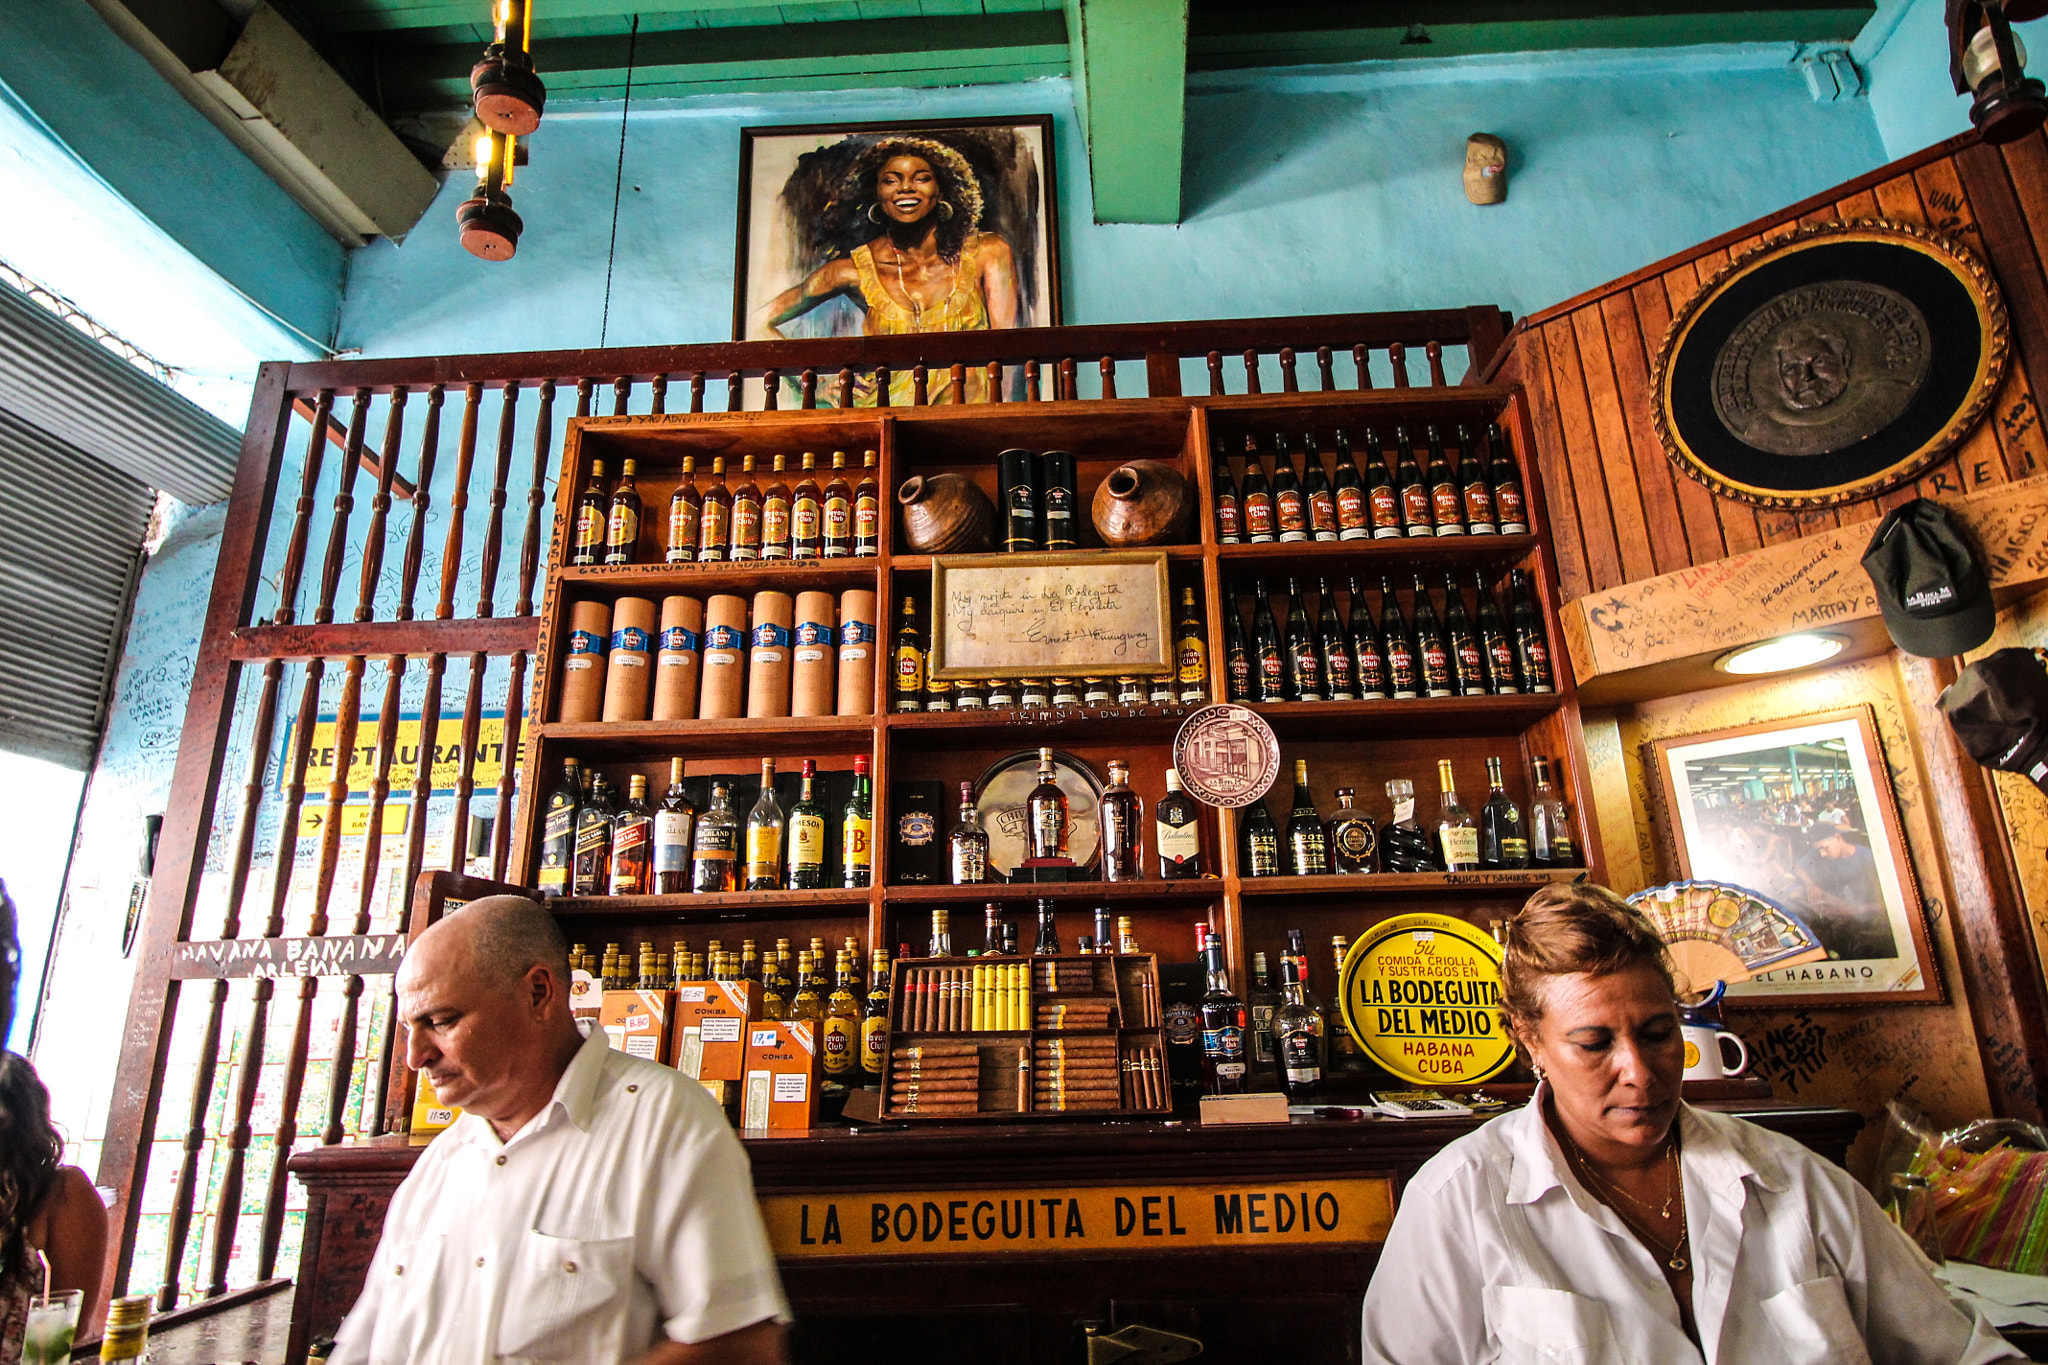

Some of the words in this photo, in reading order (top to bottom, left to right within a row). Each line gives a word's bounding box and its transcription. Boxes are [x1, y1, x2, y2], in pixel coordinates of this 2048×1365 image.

[1928, 189, 1964, 213] IVAN
[1248, 505, 1270, 513] Havana
[767, 515, 782, 523] Club
[830, 514, 844, 522] Club
[952, 591, 972, 607] My
[980, 586, 1012, 606] mojito
[1020, 591, 1037, 600] in
[1041, 587, 1060, 599] La
[1065, 583, 1125, 601] Bodeguita
[952, 606, 973, 631] My
[1033, 606, 1046, 615] in
[1297, 655, 1318, 663] Havana
[1358, 654, 1381, 662] Havana
[1388, 653, 1412, 661] Havana
[1424, 651, 1446, 660] Havana
[1430, 657, 1444, 665] Club
[1261, 659, 1282, 667] Havana
[1393, 659, 1408, 667] Club
[129, 697, 173, 716] DANIEL
[1000, 810, 1027, 823] CHIV
[697, 830, 730, 838] HIGHLAND
[703, 836, 720, 844] PARK
[181, 940, 272, 962] HAVANA
[286, 934, 405, 962] BANANA
[1377, 955, 1422, 966] COMIDA
[1427, 956, 1476, 967] CRIOLLA
[1378, 965, 1385, 976] Y
[1463, 967, 1479, 977] EN
[1755, 971, 1774, 982] EL
[1785, 965, 1874, 982] HABANO
[1360, 979, 1384, 1004] LA
[1388, 980, 1500, 1006] BODEGUITA
[1256, 1020, 1270, 1031] OLM
[1378, 1008, 1416, 1034] DEL
[1420, 1009, 1491, 1035] MEDIO
[827, 1042, 844, 1051] Club
[1403, 1042, 1475, 1057] HABANA
[1418, 1059, 1464, 1074] CUBA
[801, 1204, 842, 1246] LA
[871, 1198, 1085, 1244] BODEGUITA
[1114, 1195, 1187, 1237] DEL
[1215, 1191, 1340, 1236] MEDIO
